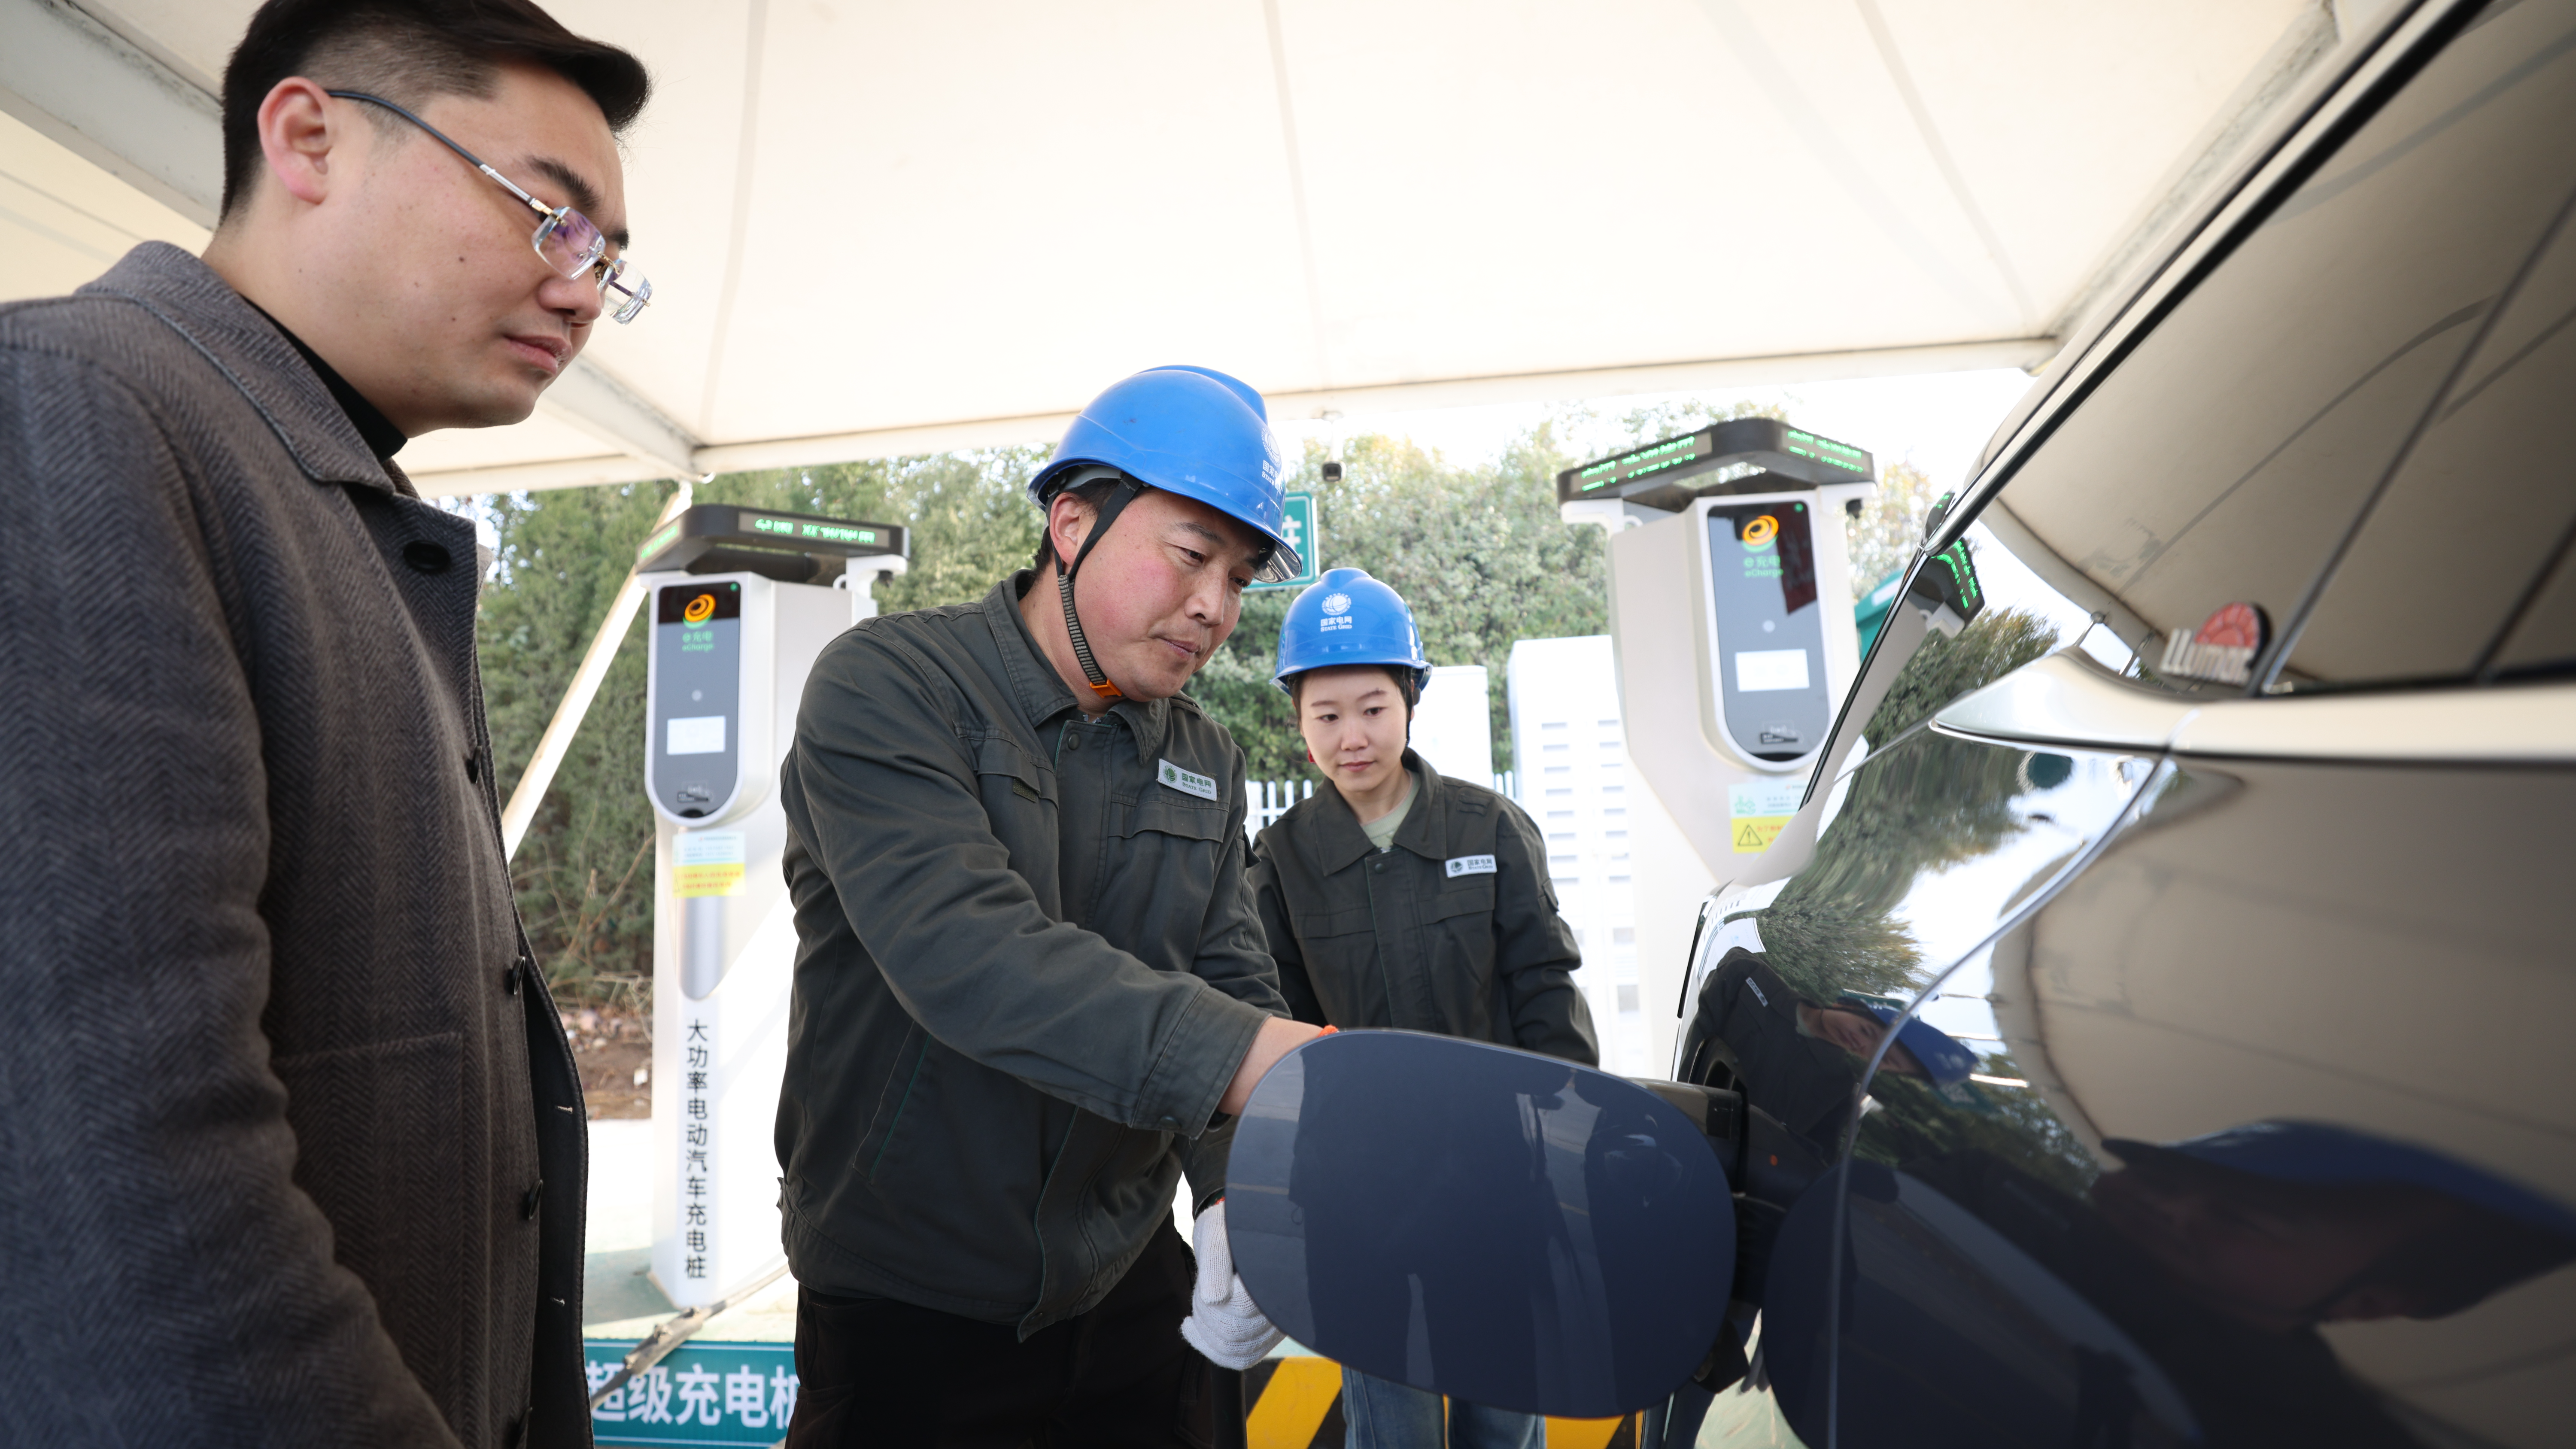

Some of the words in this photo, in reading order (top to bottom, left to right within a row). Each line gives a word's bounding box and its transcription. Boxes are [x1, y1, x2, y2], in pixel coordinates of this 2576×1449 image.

[1263, 460, 1280, 479] 国家电
[1321, 616, 1352, 626] 国家电网
[1182, 773, 1211, 788] 国家电网
[1182, 782, 1197, 790] STATE
[685, 1019, 708, 1279] 大功率电动汽车充电桩
